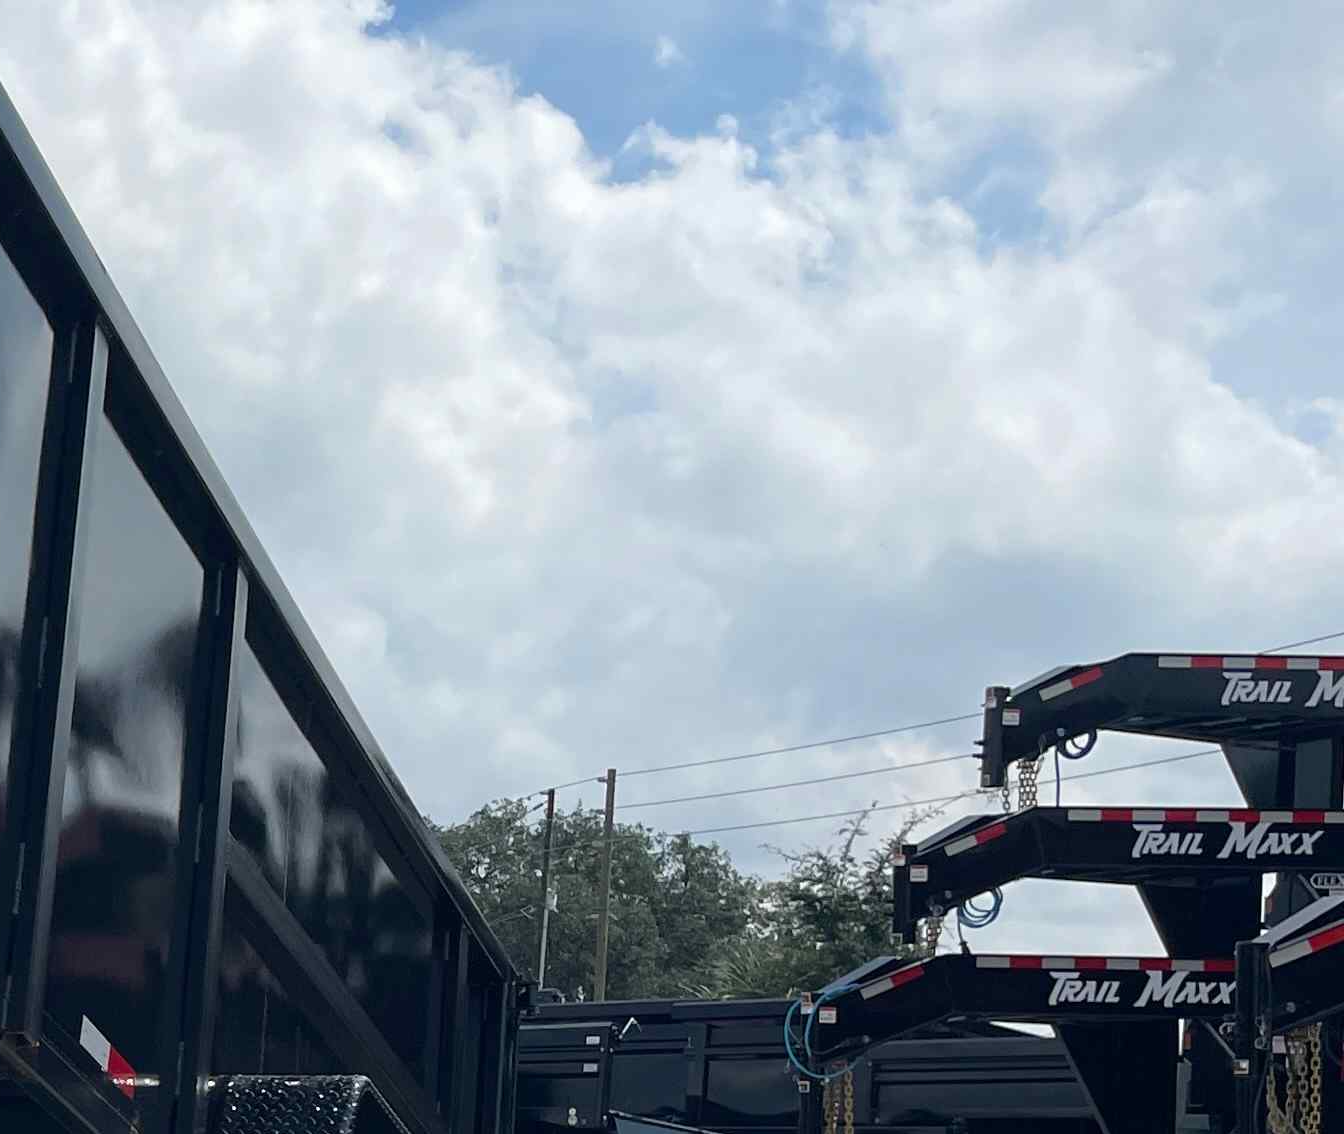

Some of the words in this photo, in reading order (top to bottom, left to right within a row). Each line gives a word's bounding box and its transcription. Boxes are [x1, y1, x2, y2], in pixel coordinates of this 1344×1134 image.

[1221, 672, 1292, 706] TRAIL
[1132, 824, 1204, 858] TRAIL
[1216, 822, 1325, 859] MAXX
[1048, 971, 1121, 1006] TRAIL
[1133, 970, 1237, 1008] MAXX
